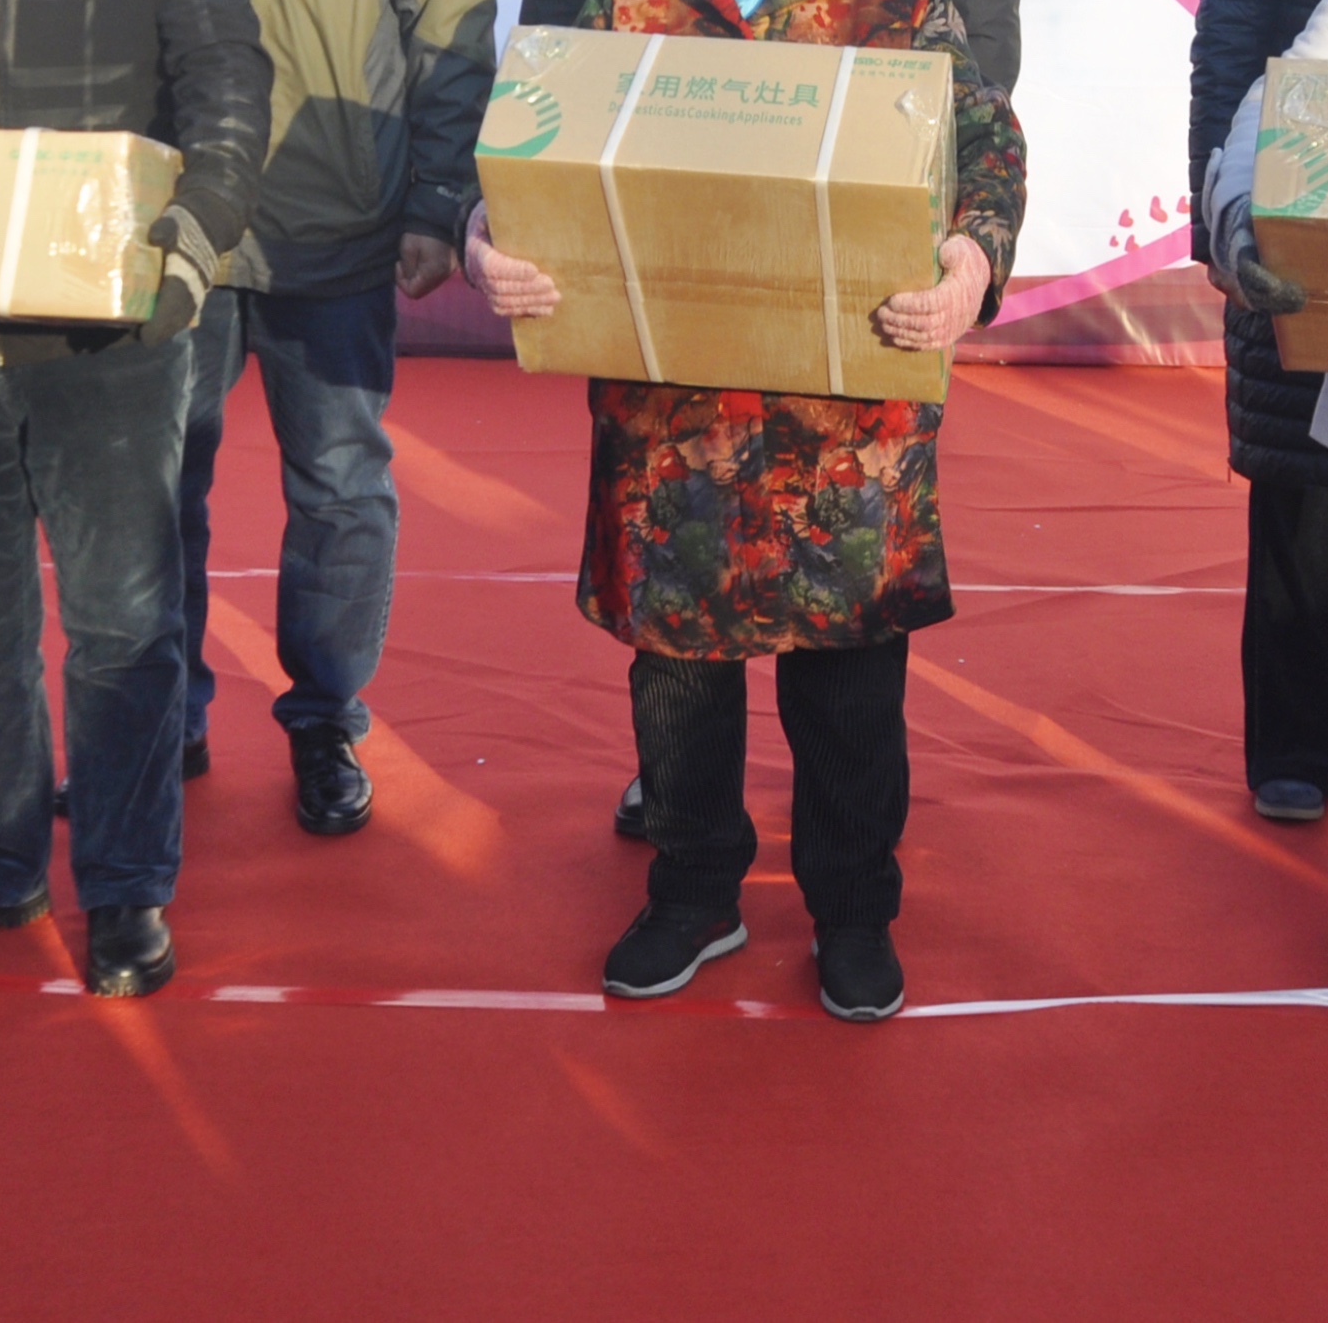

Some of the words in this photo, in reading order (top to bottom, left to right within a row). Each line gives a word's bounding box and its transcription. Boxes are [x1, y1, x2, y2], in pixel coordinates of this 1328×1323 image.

[616, 71, 820, 108] 家用燃气灶具
[608, 101, 804, 127] DoesticGasCookingAppliances
